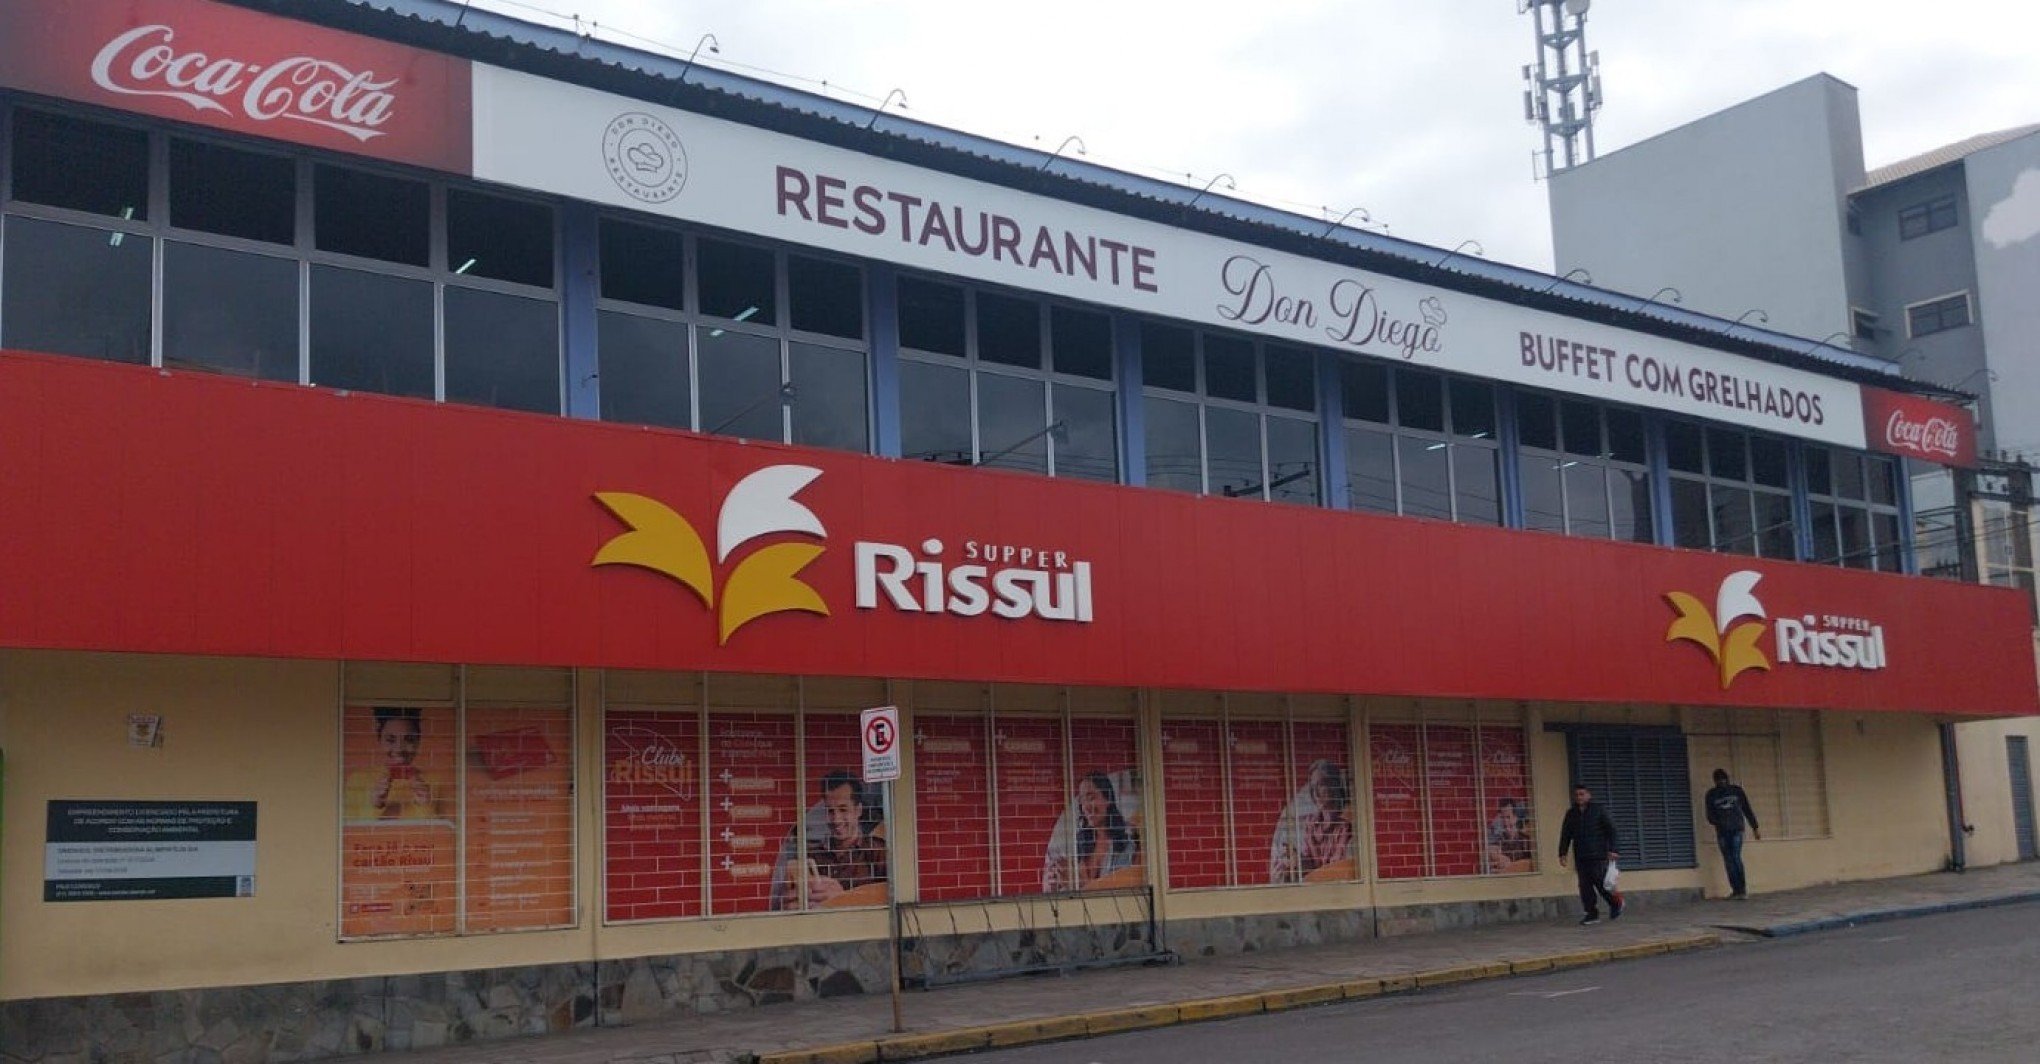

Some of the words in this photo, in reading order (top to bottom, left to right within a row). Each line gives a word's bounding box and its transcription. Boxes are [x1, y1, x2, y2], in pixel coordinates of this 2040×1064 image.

[91, 25, 398, 141] Coca-Cola
[775, 165, 1158, 293] RESTAURANTE
[1217, 254, 1317, 328] Don
[1326, 279, 1442, 359] Diego
[1519, 331, 1616, 382] BUFFET
[1625, 353, 1684, 397] COM
[1688, 368, 1824, 425] GRELHADOS
[1886, 409, 1958, 457] Coca-Cola
[854, 538, 1093, 622] Rissul
[966, 541, 1069, 568] SUPPER
[1774, 615, 1886, 669] Rissul
[1822, 615, 1870, 631] SUPPER
